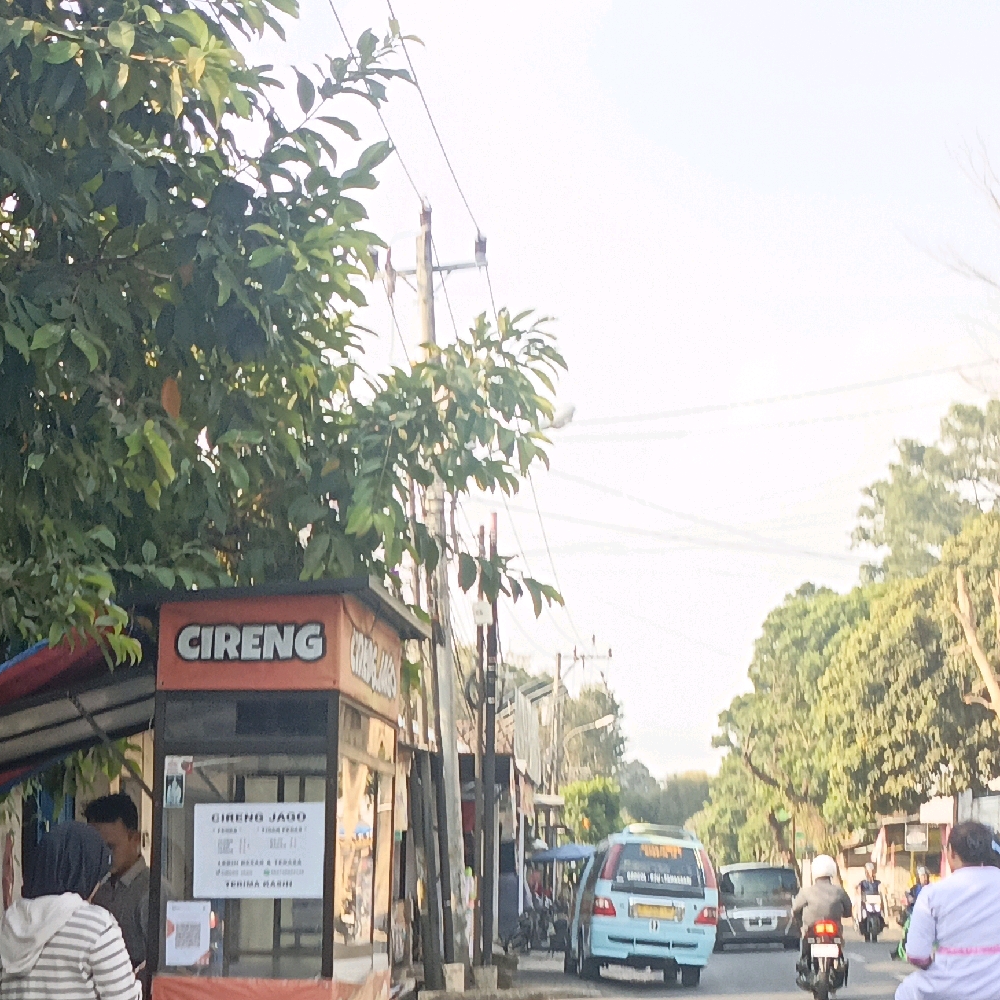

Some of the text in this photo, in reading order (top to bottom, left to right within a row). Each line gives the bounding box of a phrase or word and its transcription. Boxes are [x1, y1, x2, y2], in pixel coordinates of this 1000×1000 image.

[176, 622, 325, 661] CIRENG
[211, 810, 307, 823] CIRENG JAGO
